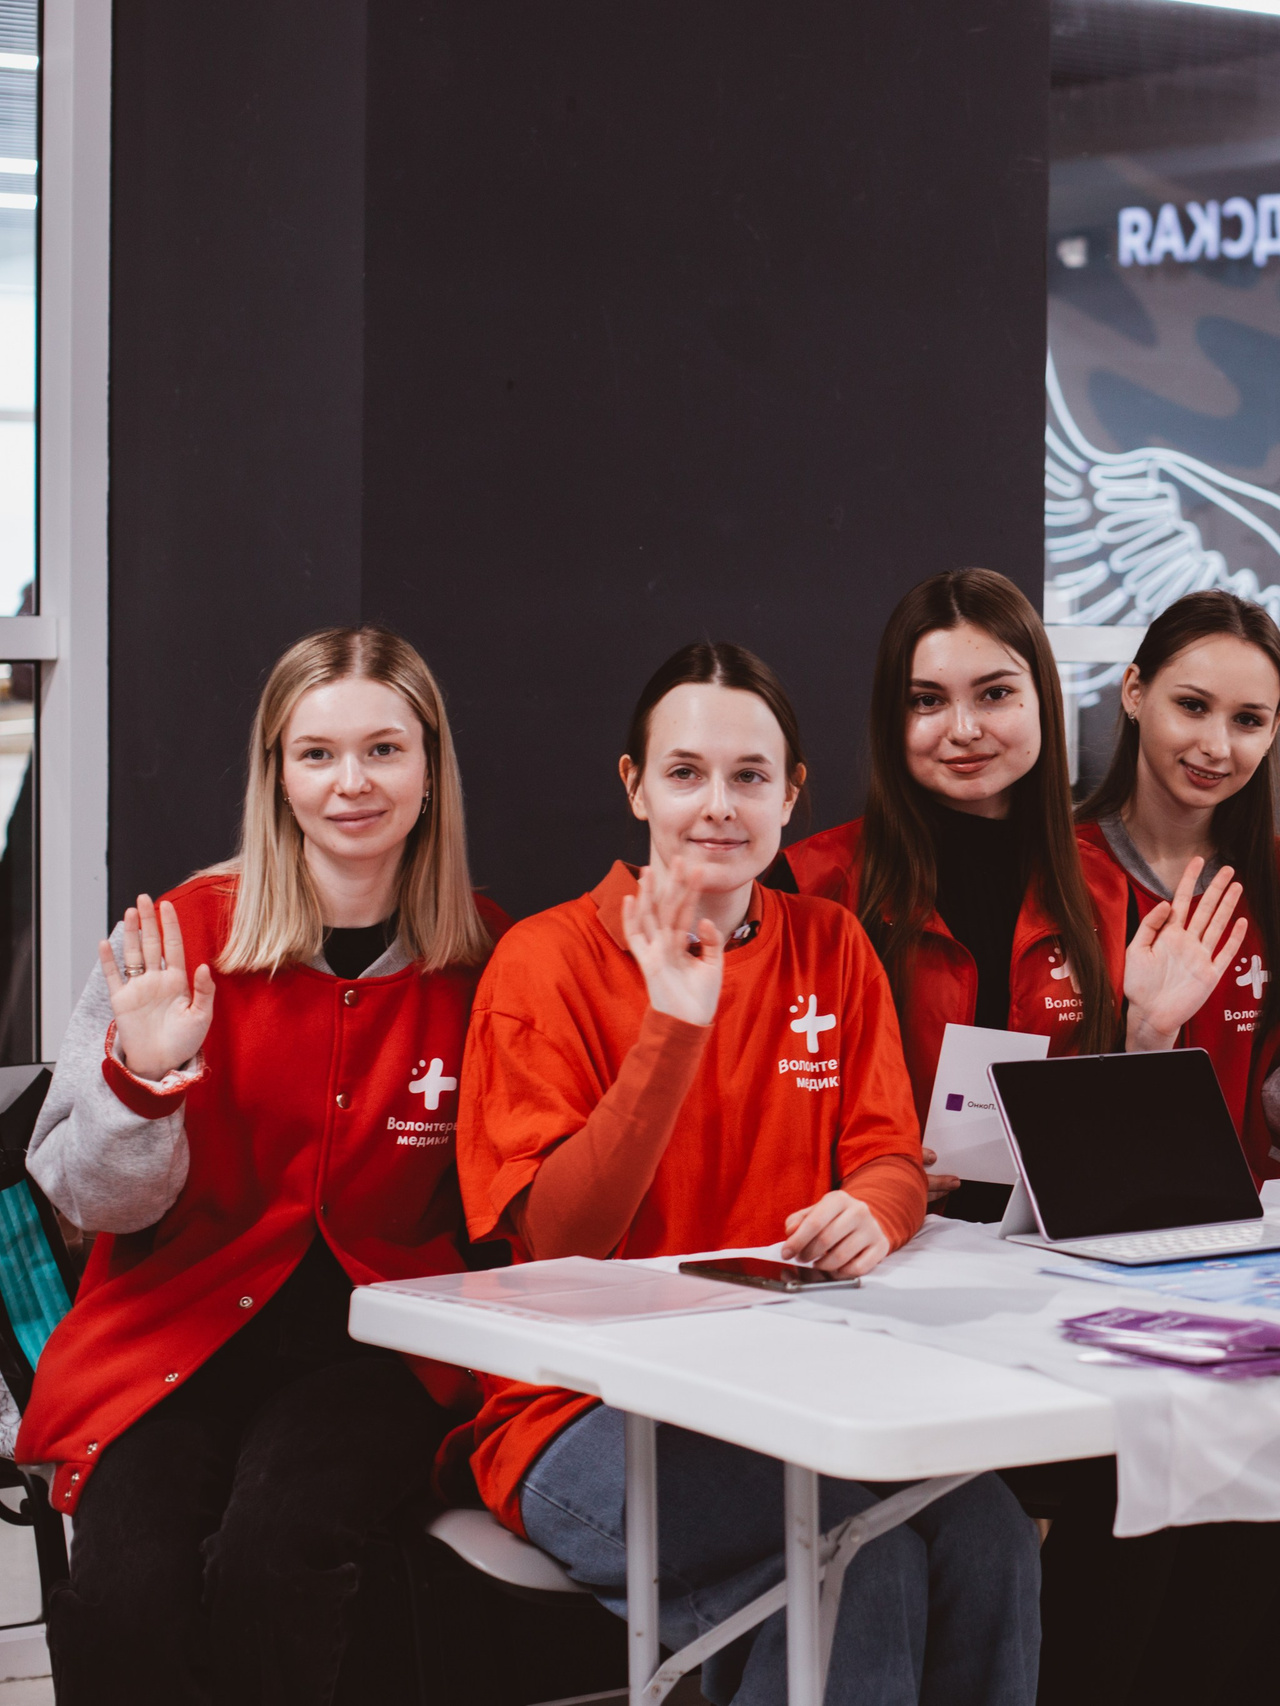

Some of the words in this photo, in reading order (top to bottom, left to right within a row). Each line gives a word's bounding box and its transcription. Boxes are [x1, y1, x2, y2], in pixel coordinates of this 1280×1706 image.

[778, 1058, 839, 1075] Волонте
[796, 1075, 840, 1092] медик
[967, 1100, 996, 1110] ОнкоП
[396, 1135, 449, 1148] медики
